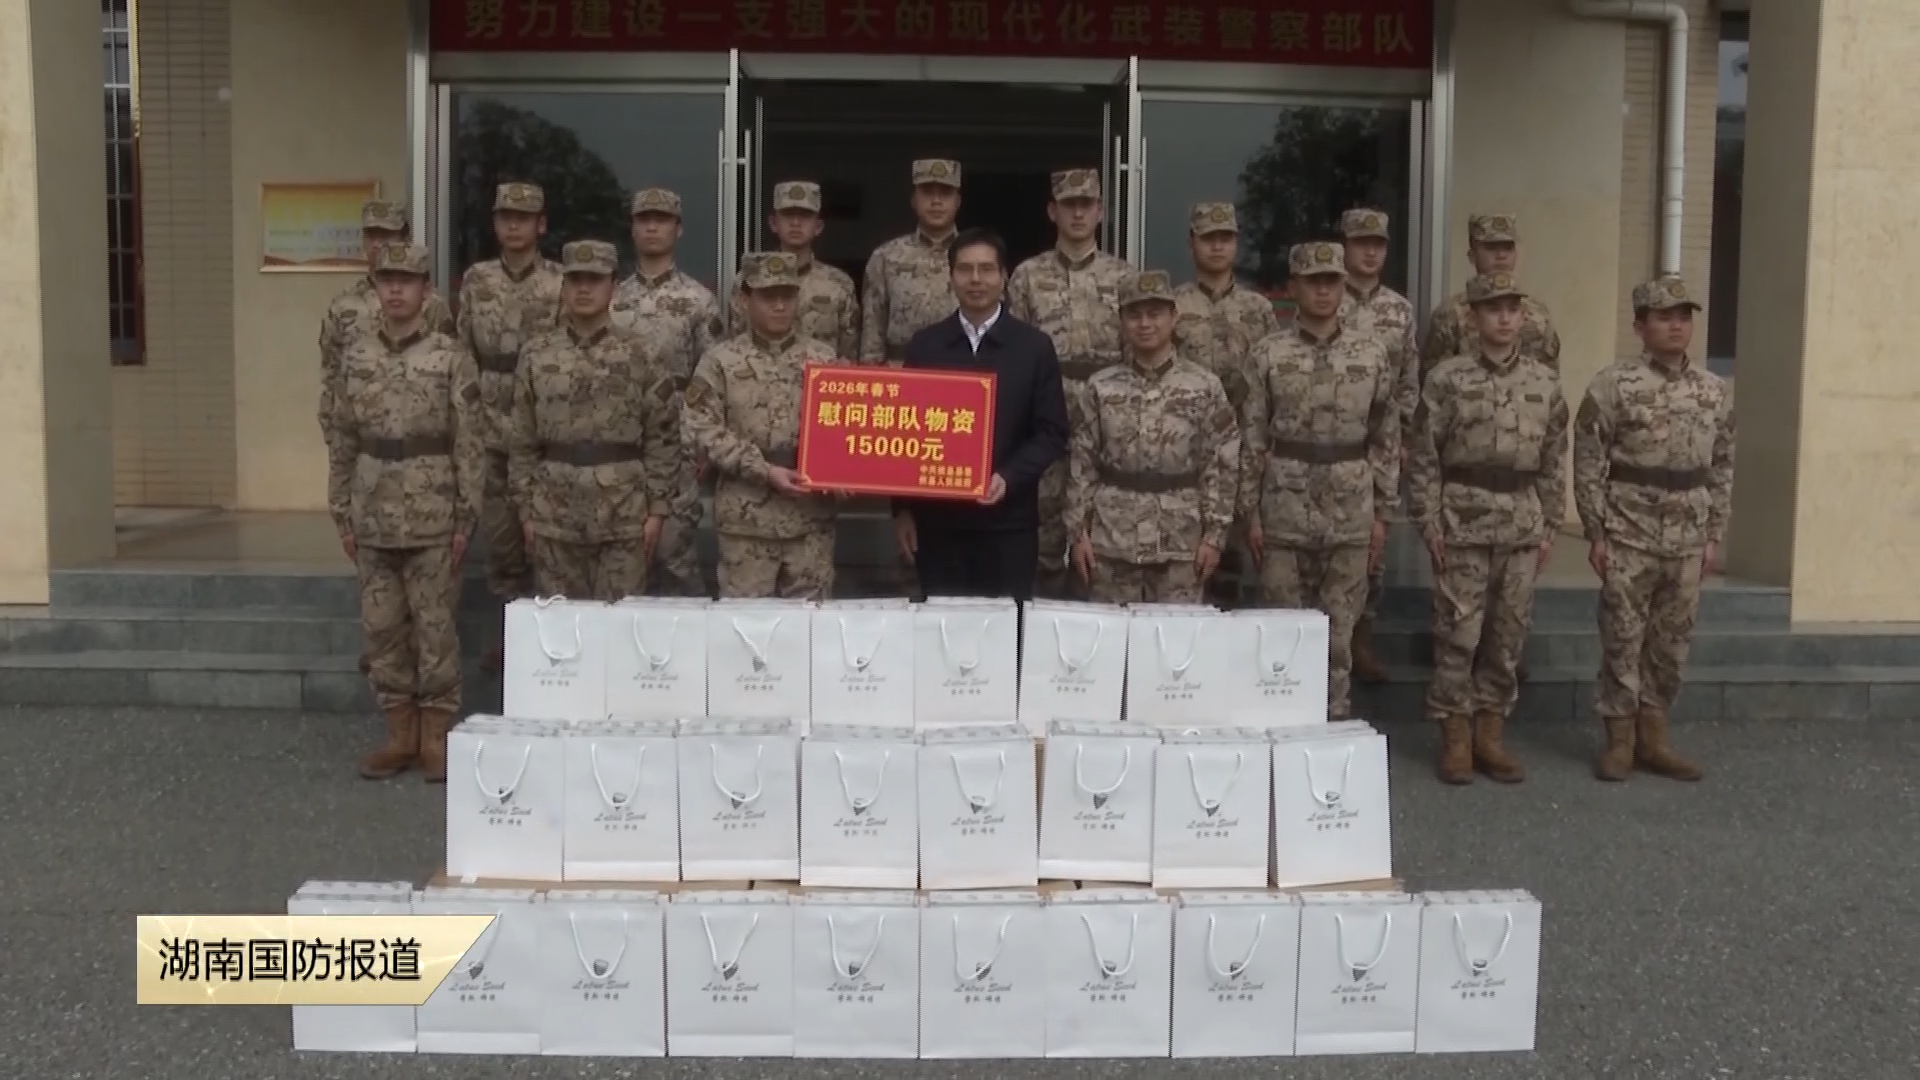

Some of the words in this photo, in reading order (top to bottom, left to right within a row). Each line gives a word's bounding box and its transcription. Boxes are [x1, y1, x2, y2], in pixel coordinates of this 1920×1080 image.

[464, 0, 1415, 54] 努力建设一支强大的现代化武装警察部队
[818, 380, 901, 399] 2026年春节
[817, 402, 976, 434] 慰问部队物资
[845, 434, 945, 462] 15000元
